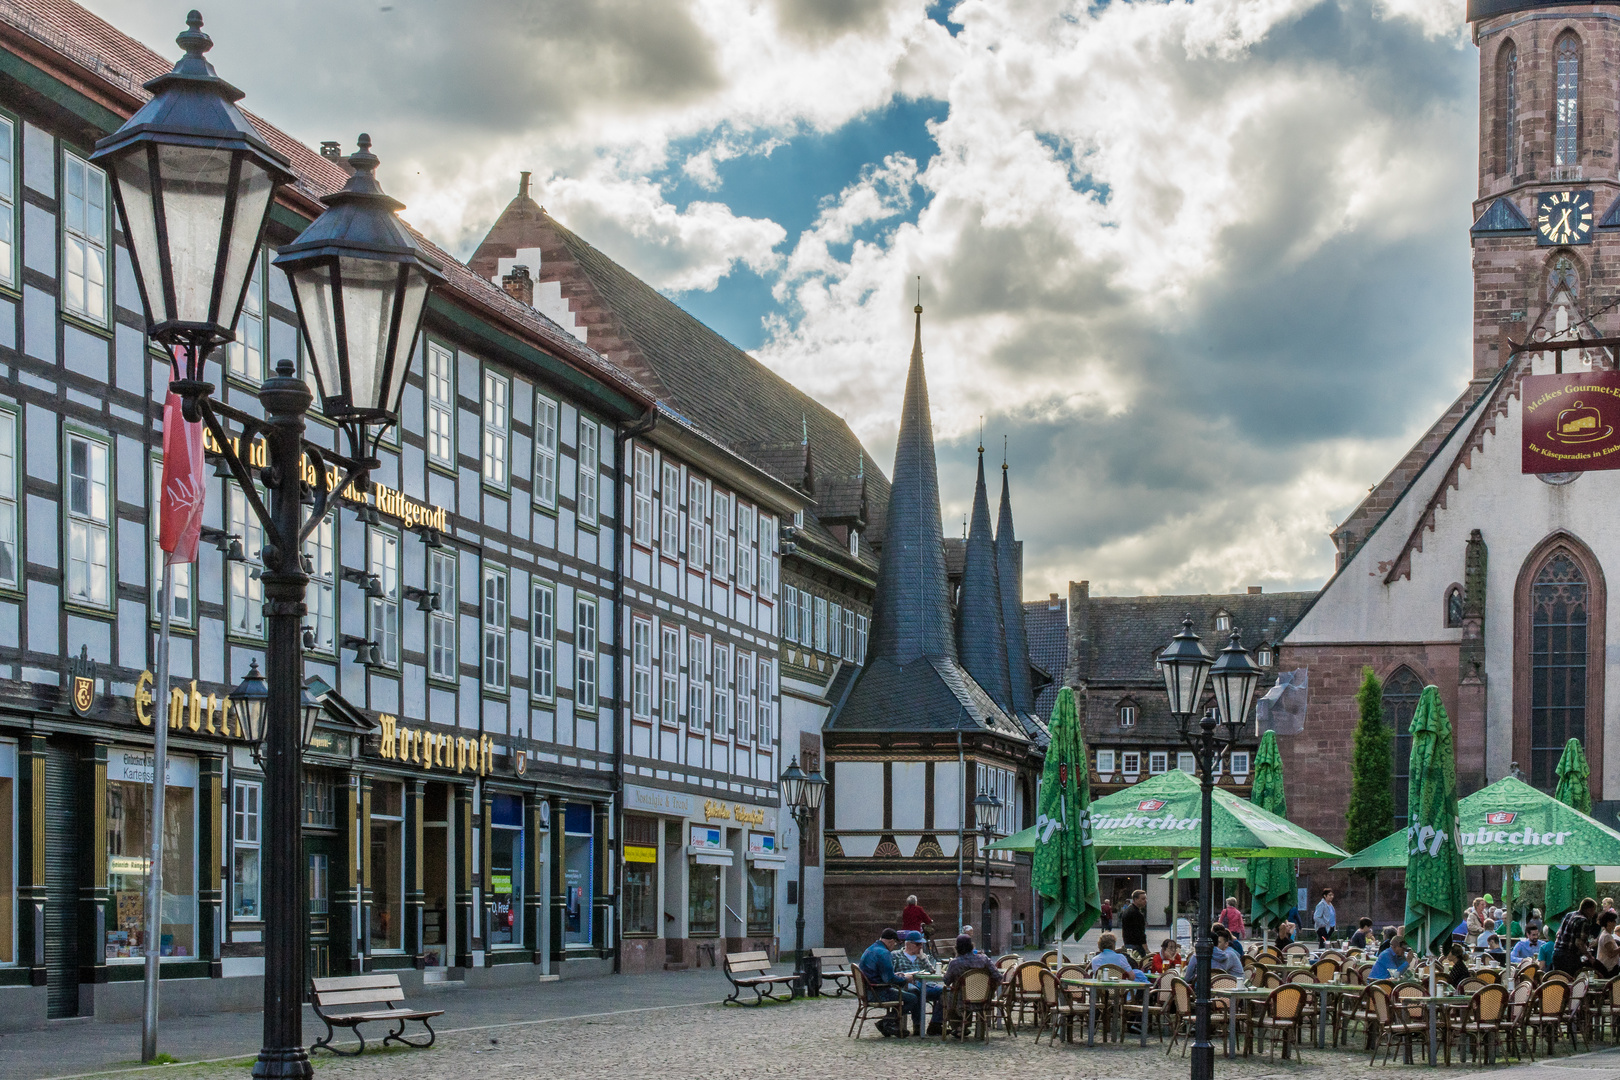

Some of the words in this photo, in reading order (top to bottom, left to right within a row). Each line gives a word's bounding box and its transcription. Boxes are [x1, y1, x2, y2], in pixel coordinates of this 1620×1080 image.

[1527, 389, 1562, 413] Meikes
[1528, 443, 1540, 453] Ihr
[1540, 448, 1591, 461] Käseparadies
[1592, 448, 1602, 458] in
[376, 482, 447, 533] Rüttgerodt
[635, 789, 663, 809] Nostalgie
[665, 795, 670, 808] &
[673, 796, 688, 811] Trend
[498, 901, 510, 913] Free
